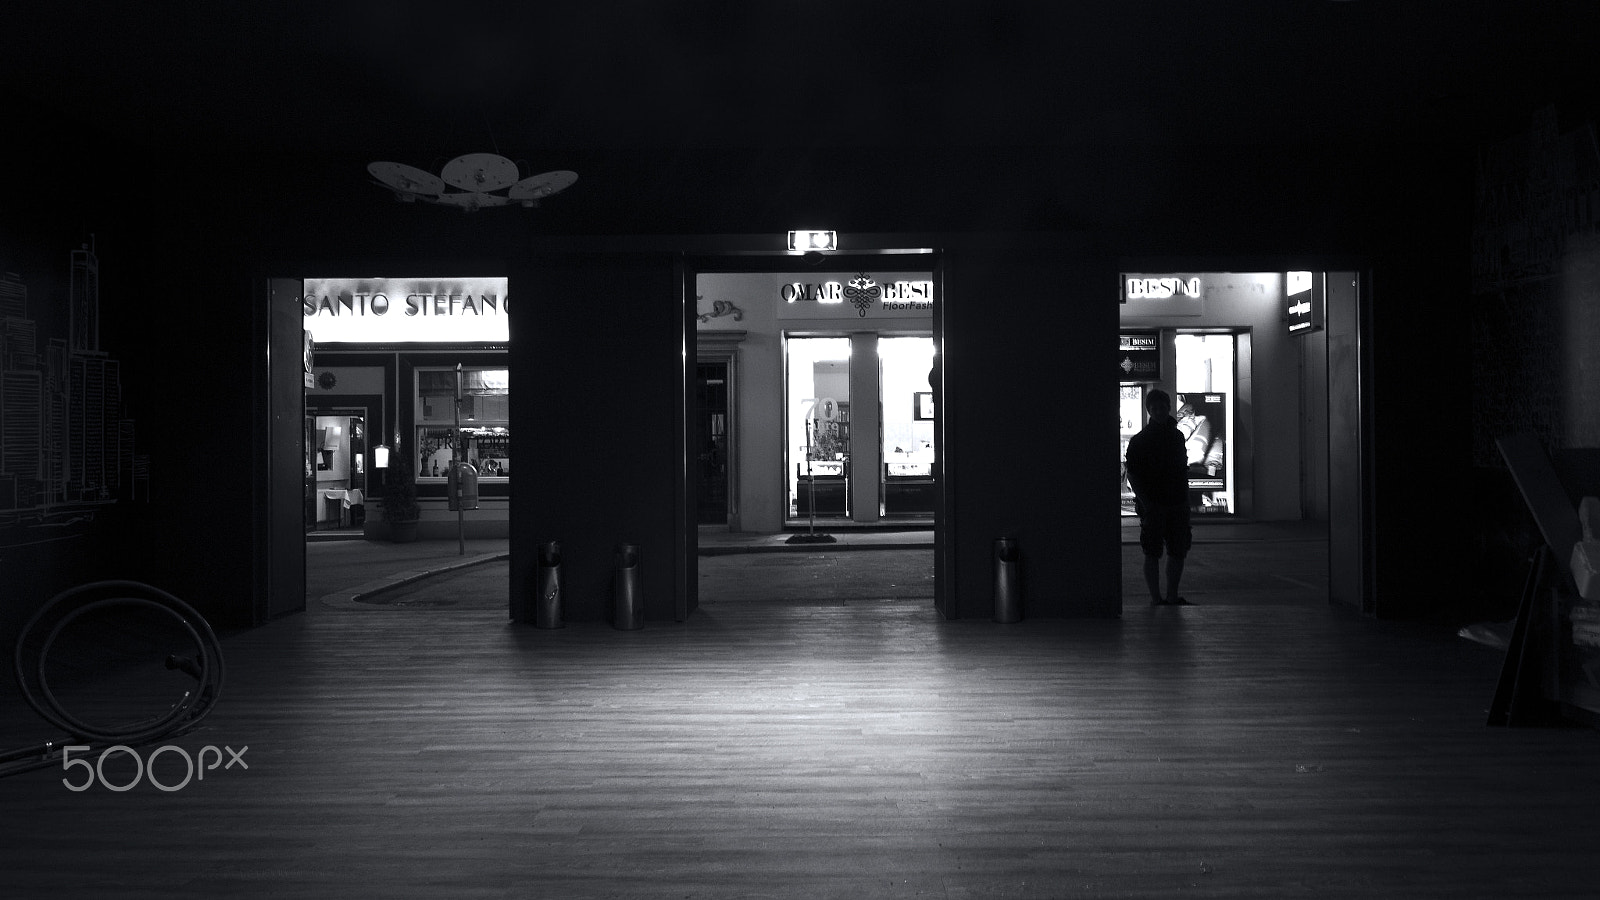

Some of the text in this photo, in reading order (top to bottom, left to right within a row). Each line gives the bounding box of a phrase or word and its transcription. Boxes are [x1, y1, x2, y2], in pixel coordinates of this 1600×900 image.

[781, 282, 842, 302] OMAR
[1129, 278, 1200, 297] BESIM
[303, 292, 389, 316] SANTO
